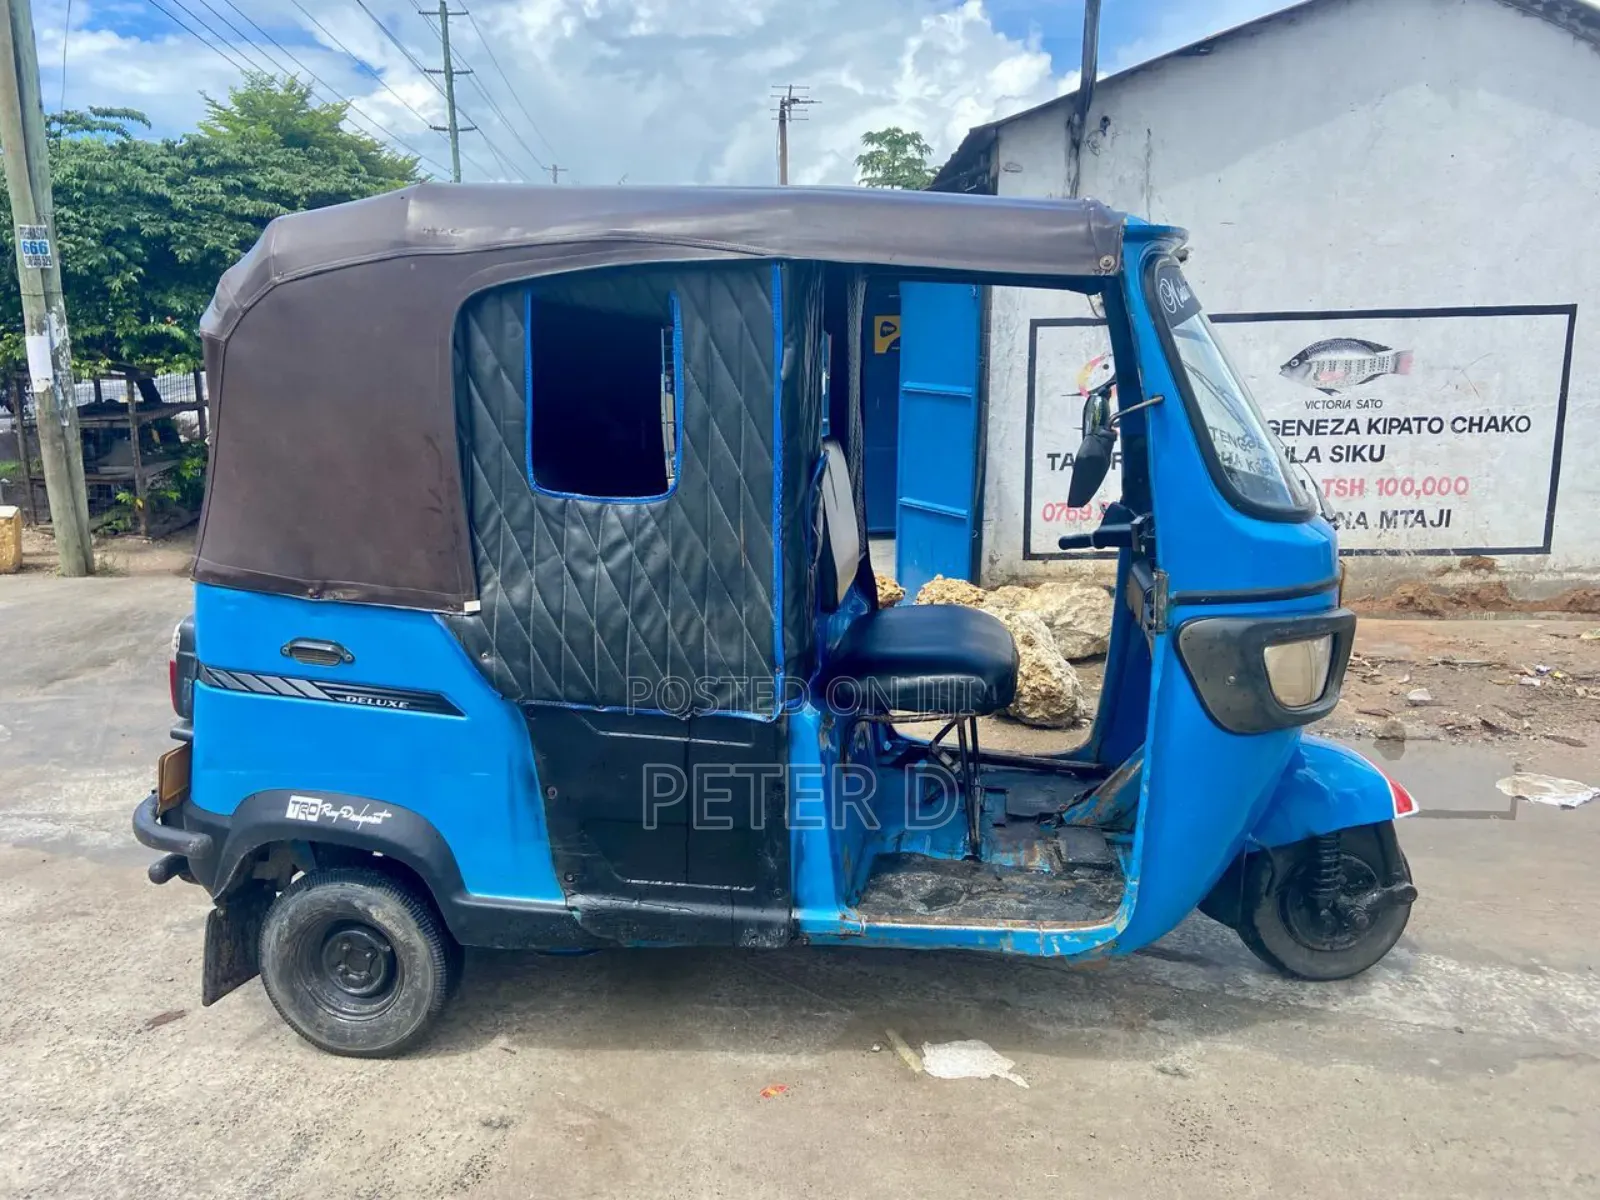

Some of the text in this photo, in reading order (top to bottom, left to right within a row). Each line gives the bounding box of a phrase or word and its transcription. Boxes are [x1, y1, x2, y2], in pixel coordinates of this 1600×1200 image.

[22, 240, 49, 255] 666
[1305, 398, 1384, 410] VICTORIA SATO
[1366, 416, 1445, 435] KIPATO
[1450, 414, 1532, 434] CHAKO
[1329, 444, 1386, 463] SIKU
[1322, 477, 1365, 498] TSH
[1375, 475, 1470, 500] 100,000
[1379, 508, 1453, 530] MTAJI
[345, 695, 410, 709] DELUXE
